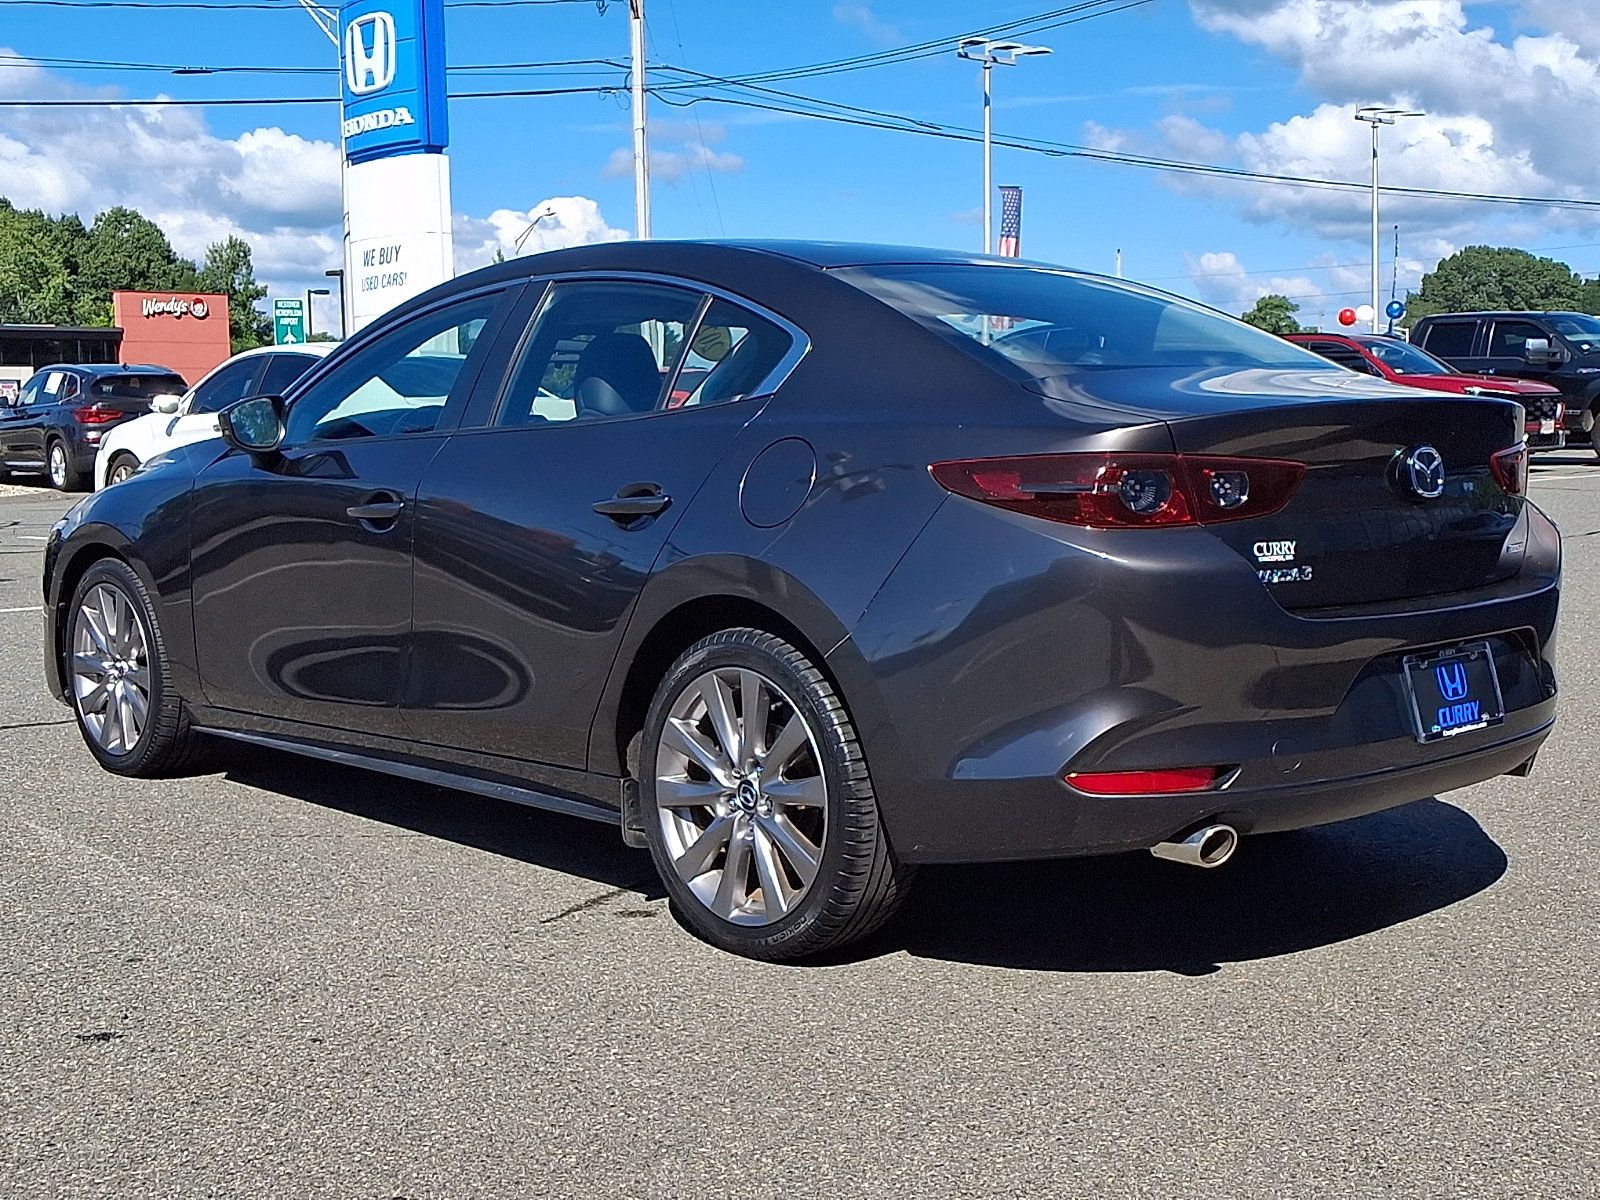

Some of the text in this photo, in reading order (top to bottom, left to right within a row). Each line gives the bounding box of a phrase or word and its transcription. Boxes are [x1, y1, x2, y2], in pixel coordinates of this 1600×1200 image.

[344, 107, 415, 136] HONDA
[363, 245, 402, 267] WE BUY
[361, 271, 407, 292] USED CARS!
[143, 297, 188, 316] Wendy's
[1253, 540, 1296, 557] CURRY
[1438, 700, 1479, 728] CURRY
